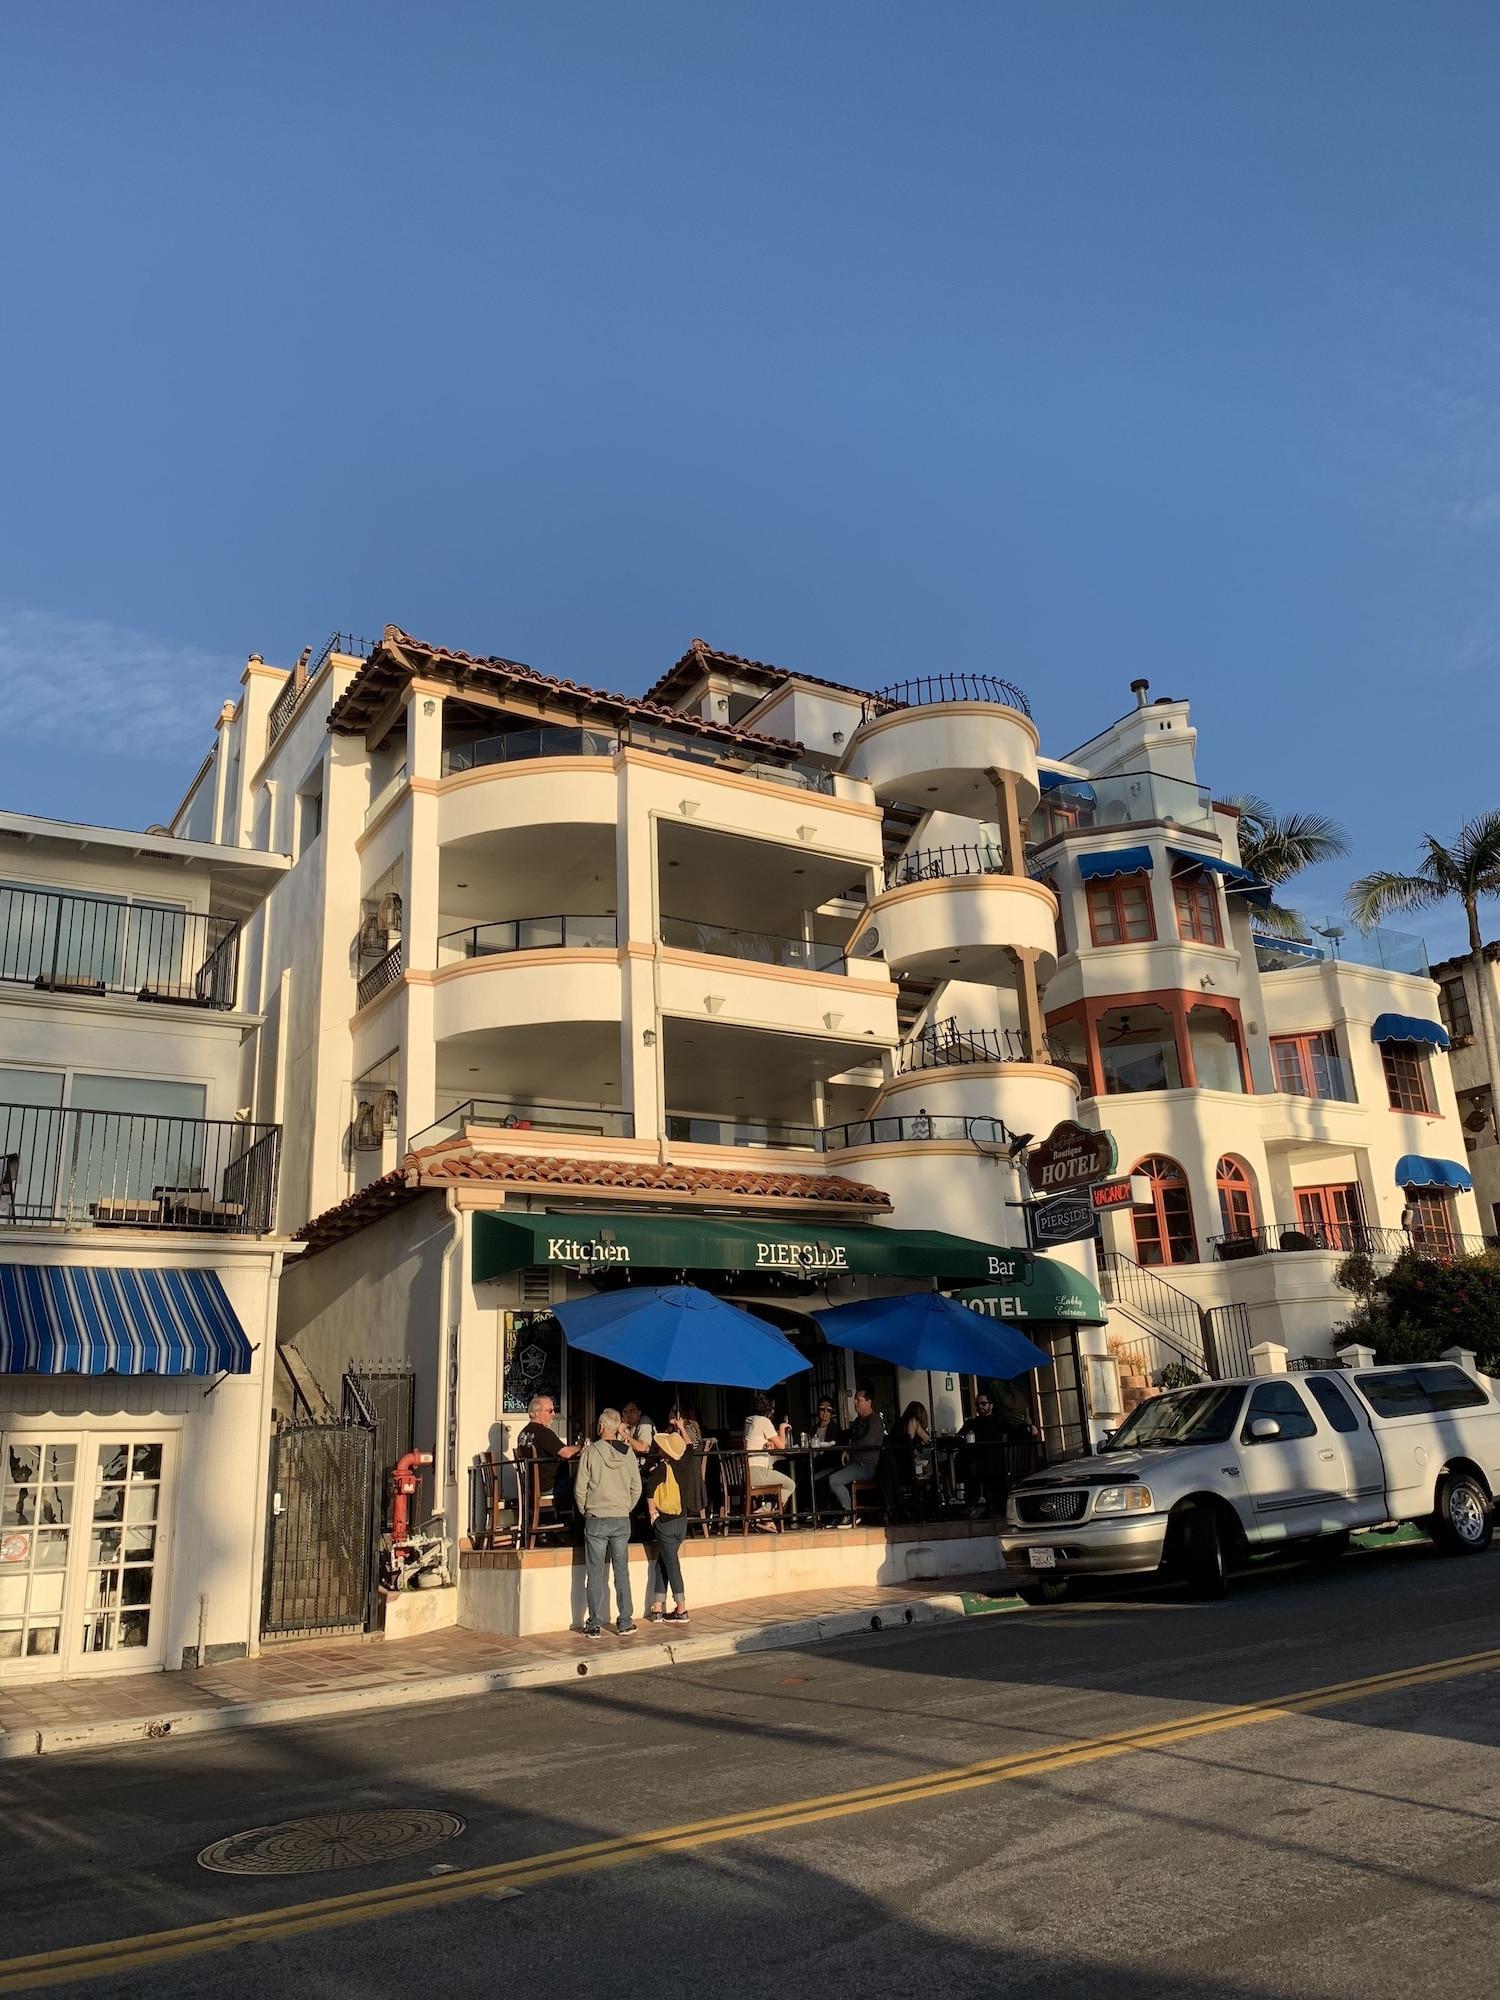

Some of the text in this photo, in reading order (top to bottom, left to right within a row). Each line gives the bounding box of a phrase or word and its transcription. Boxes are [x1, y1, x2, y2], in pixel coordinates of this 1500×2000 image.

[1053, 1146, 1082, 1160] Boutique
[1041, 1153, 1100, 1186] HOTEL
[1093, 1183, 1130, 1204] VACANCY
[1040, 1208, 1089, 1229] PIERSIDE
[547, 1239, 631, 1261] Kitchen
[756, 1243, 848, 1269] PIERSIDE
[988, 1257, 1016, 1275] Bar
[961, 1297, 1029, 1317] OTEL
[1054, 1305, 1088, 1317] Entrance
[1056, 1294, 1083, 1308] Lobby
